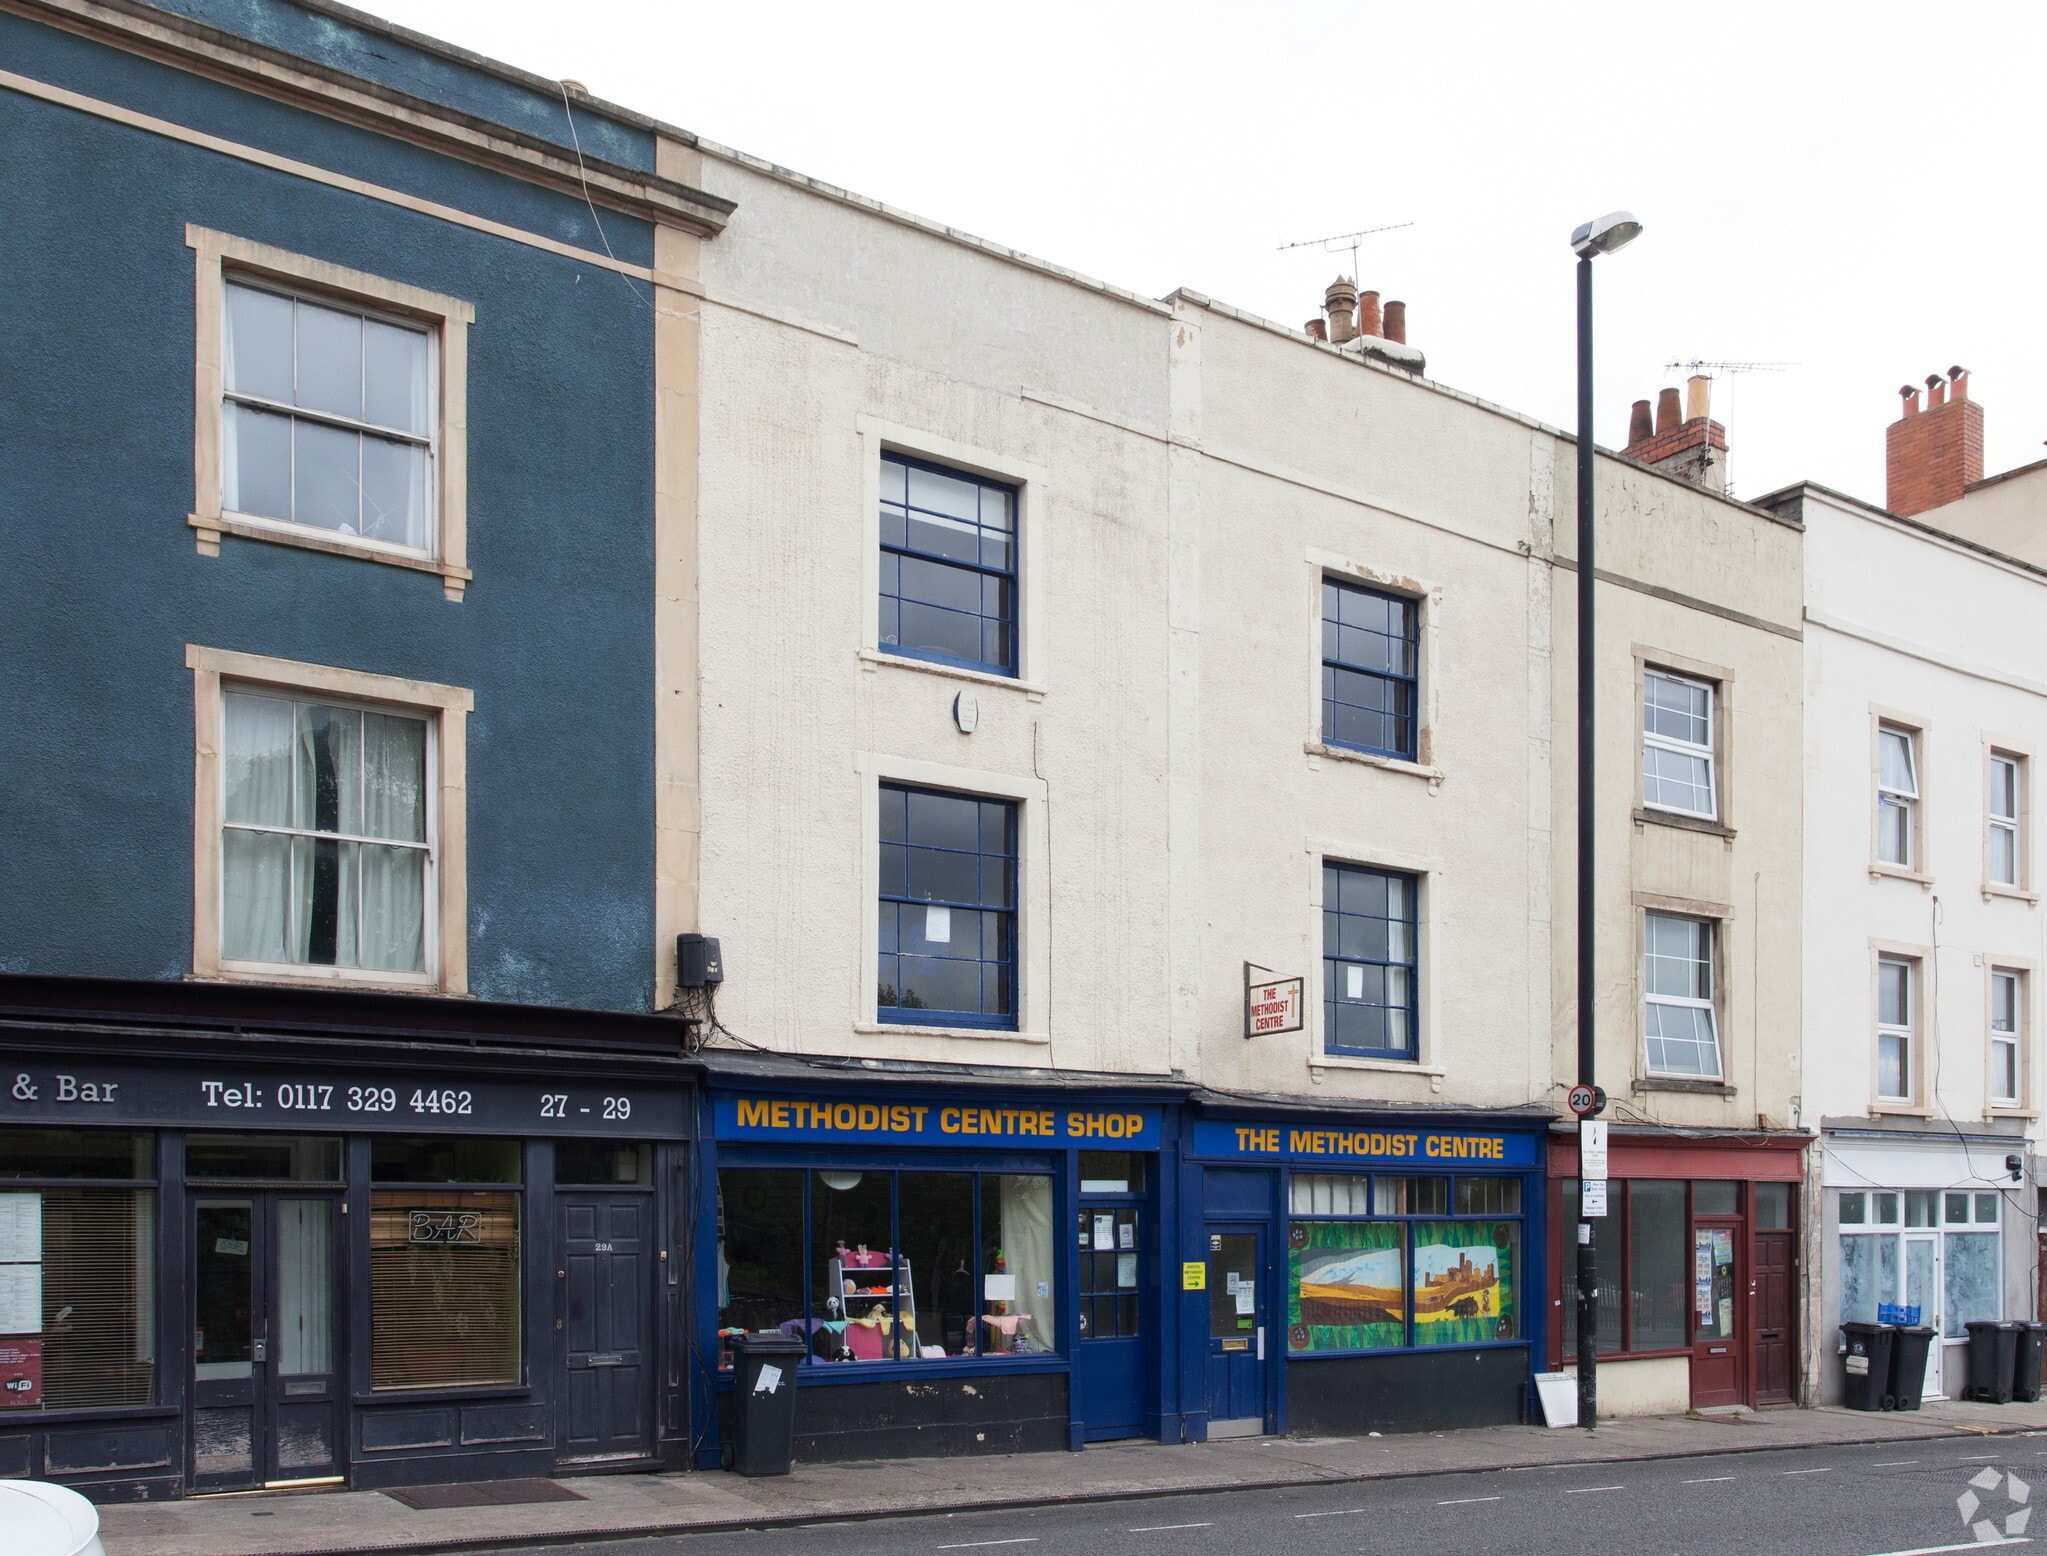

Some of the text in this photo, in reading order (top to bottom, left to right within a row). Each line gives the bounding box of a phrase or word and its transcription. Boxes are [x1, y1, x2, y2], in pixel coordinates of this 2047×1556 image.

[1263, 987, 1277, 1001] THE
[1250, 1000, 1289, 1017] METHODIST
[1256, 1015, 1284, 1031] CENTRE
[12, 1073, 118, 1103] & Bar
[201, 1081, 472, 1114] Tel: 0117 329 4462
[1572, 1093, 1591, 1107] 20
[540, 1094, 568, 1118] 27
[602, 1097, 631, 1120] 29
[736, 1099, 1143, 1139] METHODIST CENTRE SHOP
[1235, 1128, 1504, 1159] THE METHODIST CENTRE
[412, 1213, 477, 1240] BAR
[595, 1243, 613, 1252] 29A
